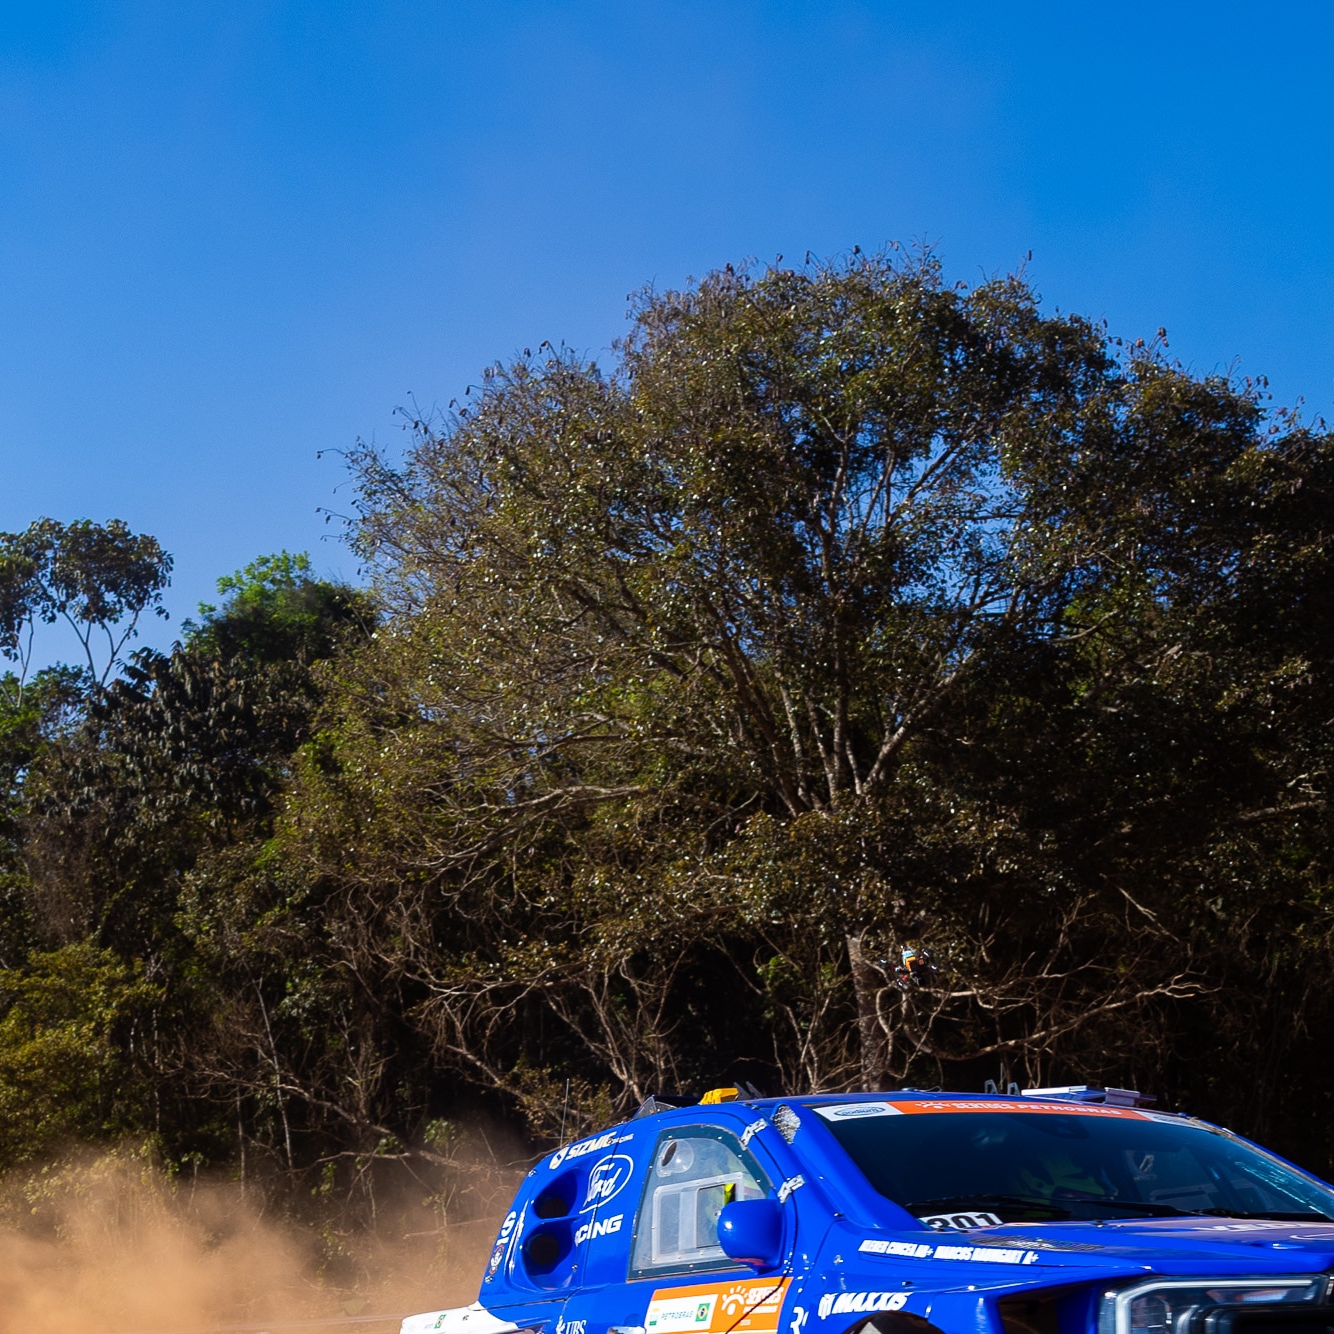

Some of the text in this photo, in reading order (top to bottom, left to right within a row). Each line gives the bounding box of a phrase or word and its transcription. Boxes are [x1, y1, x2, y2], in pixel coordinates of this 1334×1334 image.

[1017, 1104, 1122, 1115] PETROBRAS
[584, 1162, 623, 1204] Ford
[832, 1291, 914, 1314] MAXXIS
